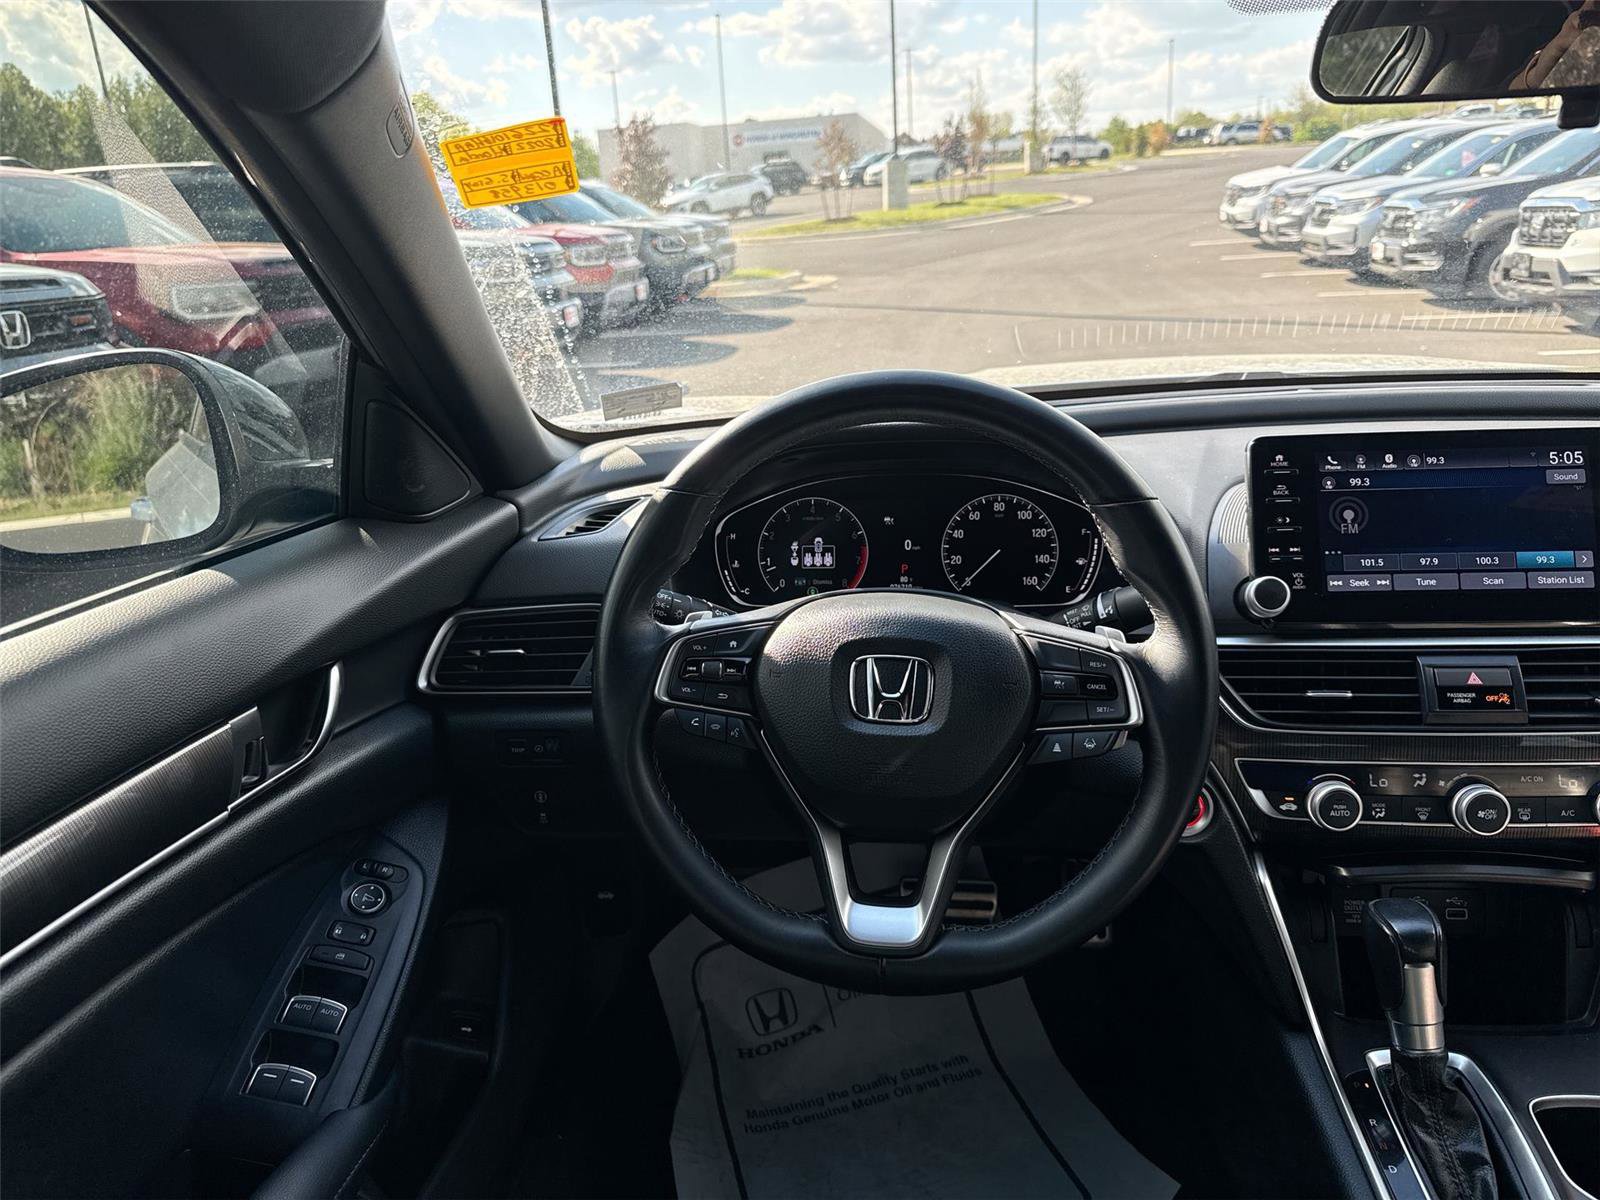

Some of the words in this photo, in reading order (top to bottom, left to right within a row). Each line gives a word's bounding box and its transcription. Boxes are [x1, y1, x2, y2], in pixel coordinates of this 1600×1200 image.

[1426, 456, 1444, 465] 99.3
[1549, 451, 1583, 465] 5:05
[1349, 477, 1370, 487] 99.3
[1553, 472, 1578, 482] Sound
[993, 502, 1005, 512] 80
[968, 511, 980, 520] 60
[1017, 510, 1032, 520] 100
[952, 529, 964, 539] 40
[1032, 528, 1047, 538] 120
[1340, 523, 1359, 535] FM
[904, 539, 912, 551] 0
[950, 555, 962, 565] 20
[1035, 554, 1050, 564] 140
[1360, 558, 1384, 567] 101.5
[1420, 557, 1439, 567] 97.9
[1475, 556, 1499, 566] 100.3
[1536, 555, 1555, 565] 99.3
[901, 562, 909, 575] P
[1022, 576, 1038, 586] 160
[1349, 578, 1370, 587] Seek
[1415, 577, 1437, 586] Tune
[1483, 577, 1504, 586] Scan
[1537, 575, 1562, 585] Station
[1569, 574, 1585, 584] List
[1329, 809, 1350, 817] AUTO
[292, 1002, 312, 1011] AUTO
[320, 1008, 340, 1017] AUTO
[737, 1024, 824, 1060] HONDA
[745, 1095, 825, 1121] Maintaining
[827, 1087, 850, 1102] the
[852, 1075, 899, 1095] Quality
[900, 1062, 940, 1080] Starts
[941, 1054, 969, 1070] with
[743, 1118, 790, 1134] Honda
[792, 1105, 850, 1126] Genuine
[852, 1092, 890, 1110] Motor
[894, 1085, 913, 1098] Oil
[916, 1077, 941, 1094] and
[942, 1067, 984, 1085] Fluids
[1368, 1118, 1378, 1127] R
[1387, 1164, 1398, 1174] D
